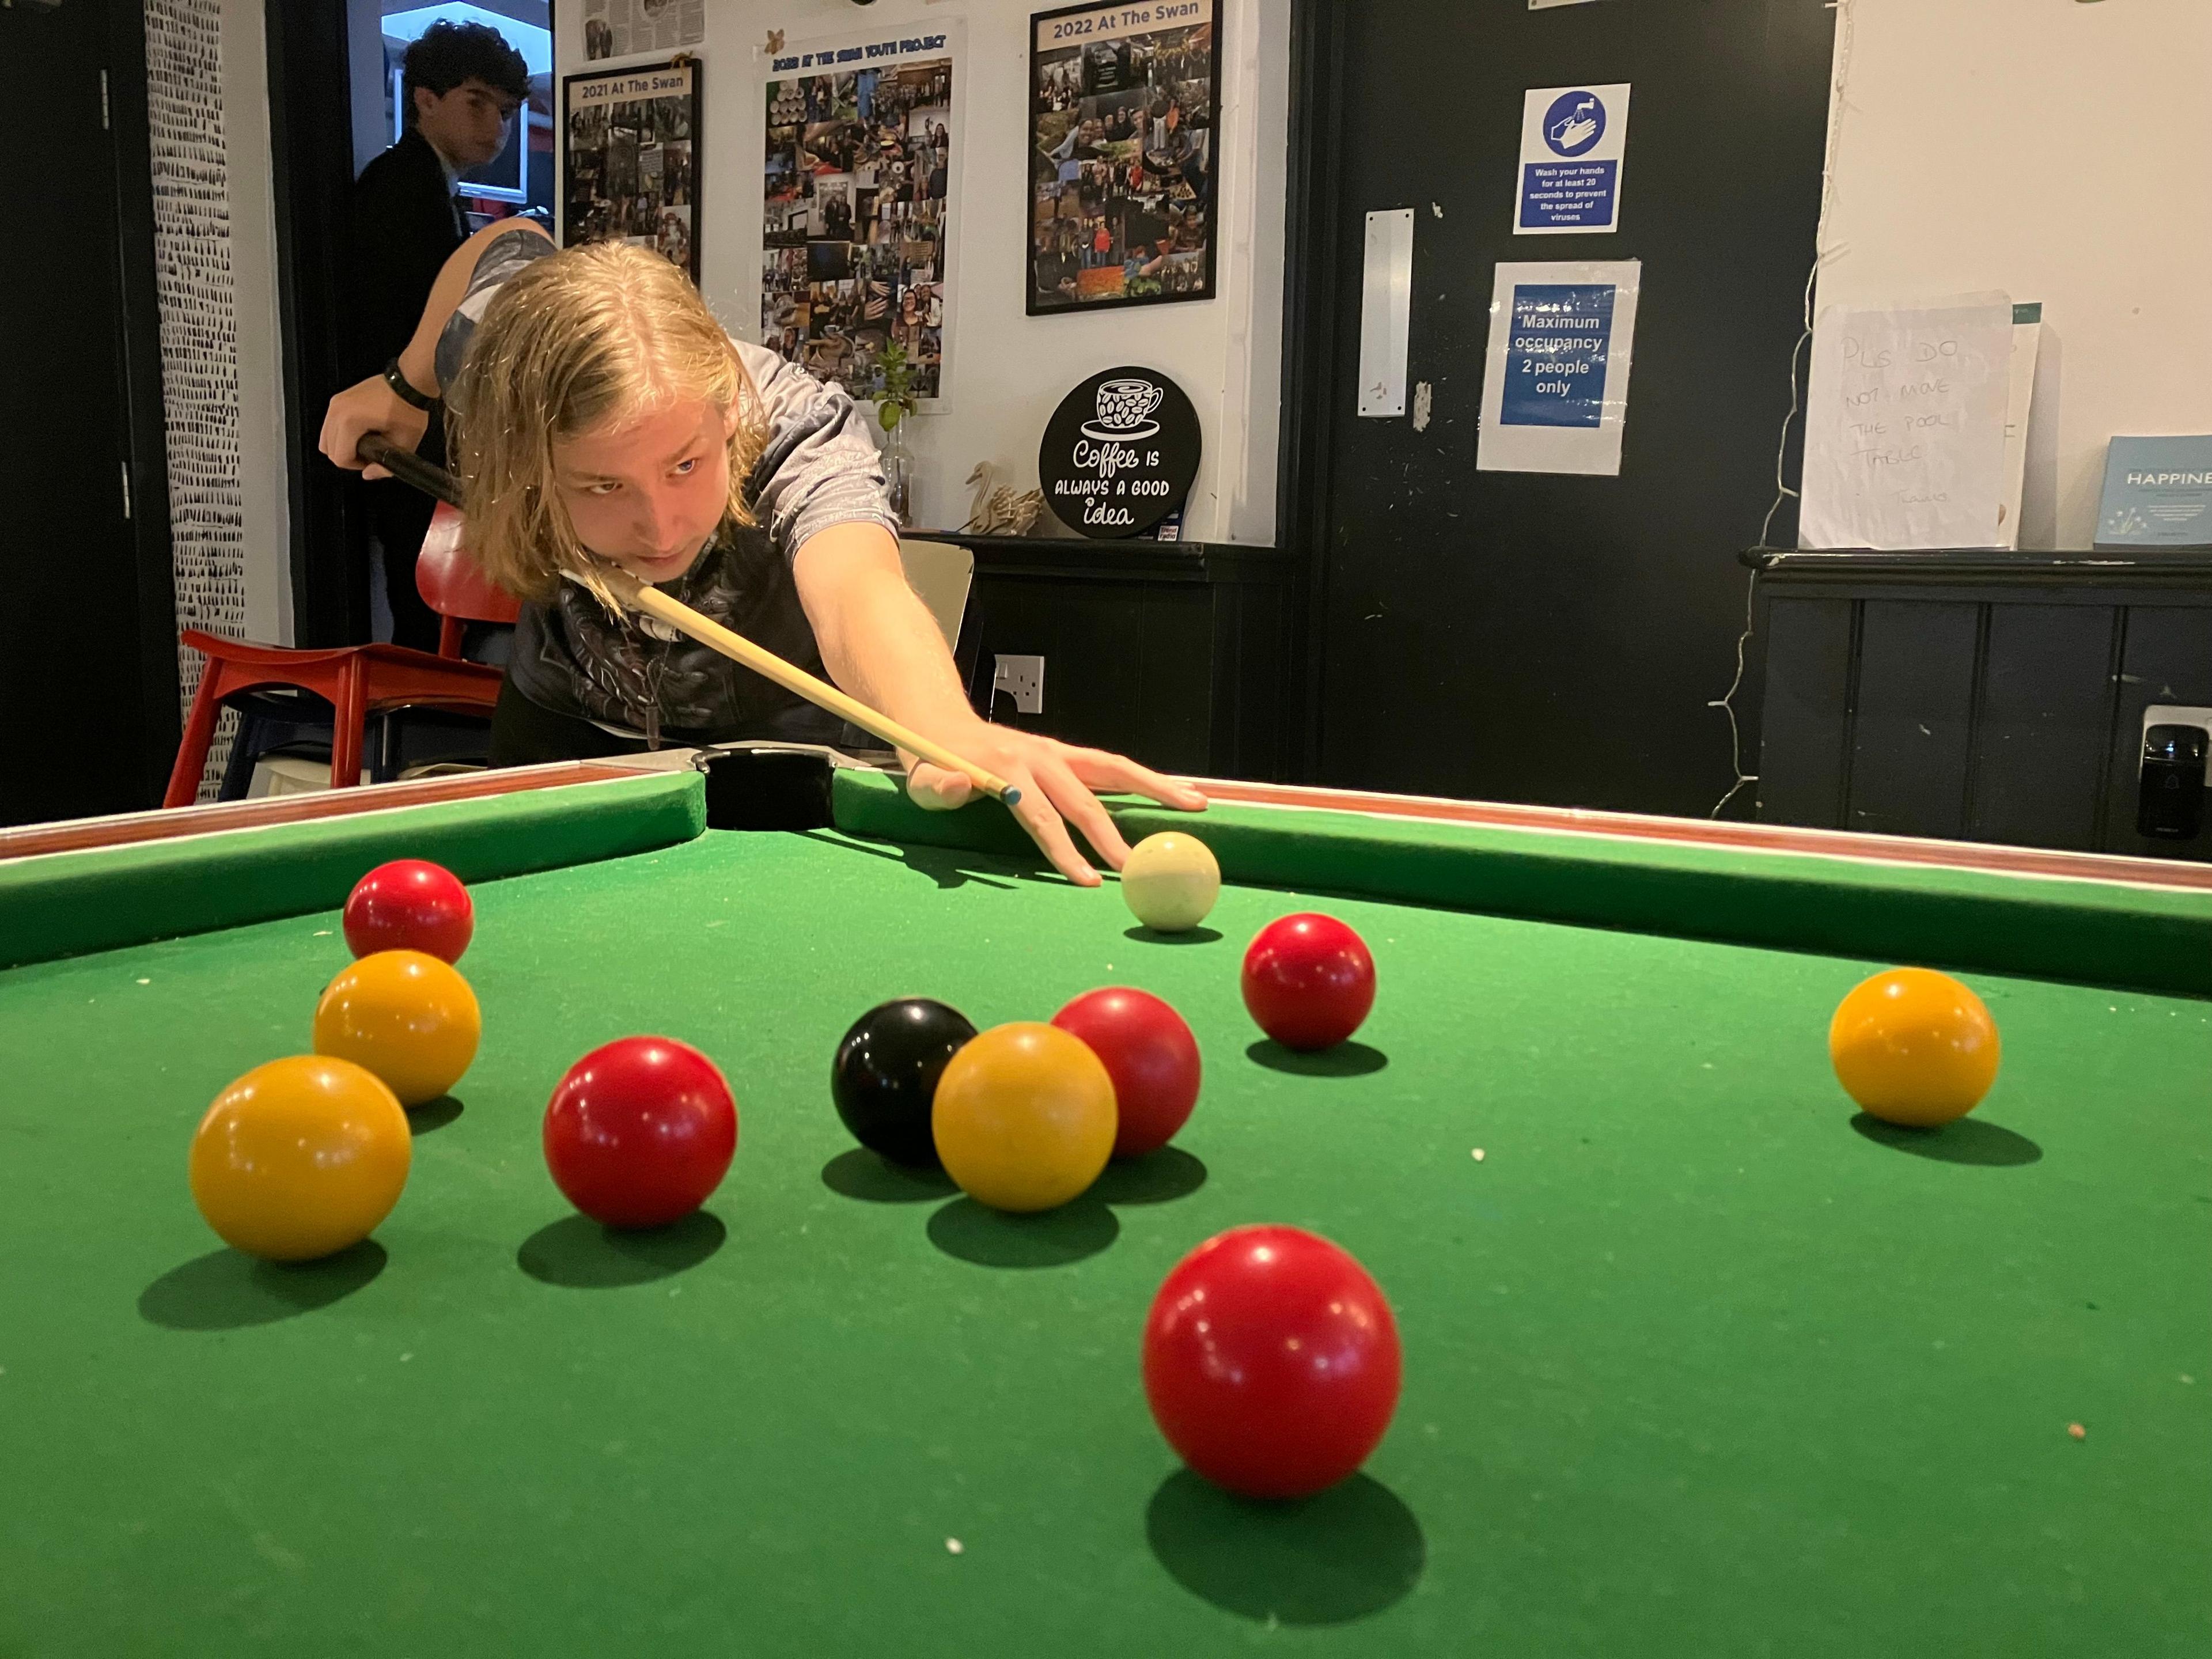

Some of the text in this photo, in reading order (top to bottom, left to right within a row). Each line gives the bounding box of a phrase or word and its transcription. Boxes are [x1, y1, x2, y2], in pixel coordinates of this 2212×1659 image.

[1054, 2, 1198, 38] 2022 At The Swan
[802, 54, 814, 67] AT
[816, 51, 835, 65] THE
[836, 47, 863, 63] SWAN
[865, 41, 897, 58] YOUTH
[899, 35, 946, 54] PROJECT
[582, 77, 684, 99] 2021 At The Swan
[1559, 169, 1578, 177] your
[1580, 166, 1605, 175] hands
[1565, 179, 1584, 187] least
[1529, 191, 1563, 199] seconds
[1575, 190, 1607, 199] prevent
[1555, 202, 1583, 211] spread
[1551, 213, 1581, 221] viruses
[1522, 315, 1600, 329] Maximum
[1515, 337, 1603, 353] occupancy
[1840, 336, 1958, 369] PLS DO
[1522, 359, 1589, 377] 2 people
[1536, 380, 1571, 397] only
[1846, 378, 1952, 407] NOT MOVE
[1849, 414, 1950, 436] THE POOL
[1073, 440, 1160, 479] Coffee IS
[1850, 445, 1922, 468] TABLE
[1055, 479, 1170, 497] ALWAYS A GOOD
[1083, 497, 1135, 525] idea
